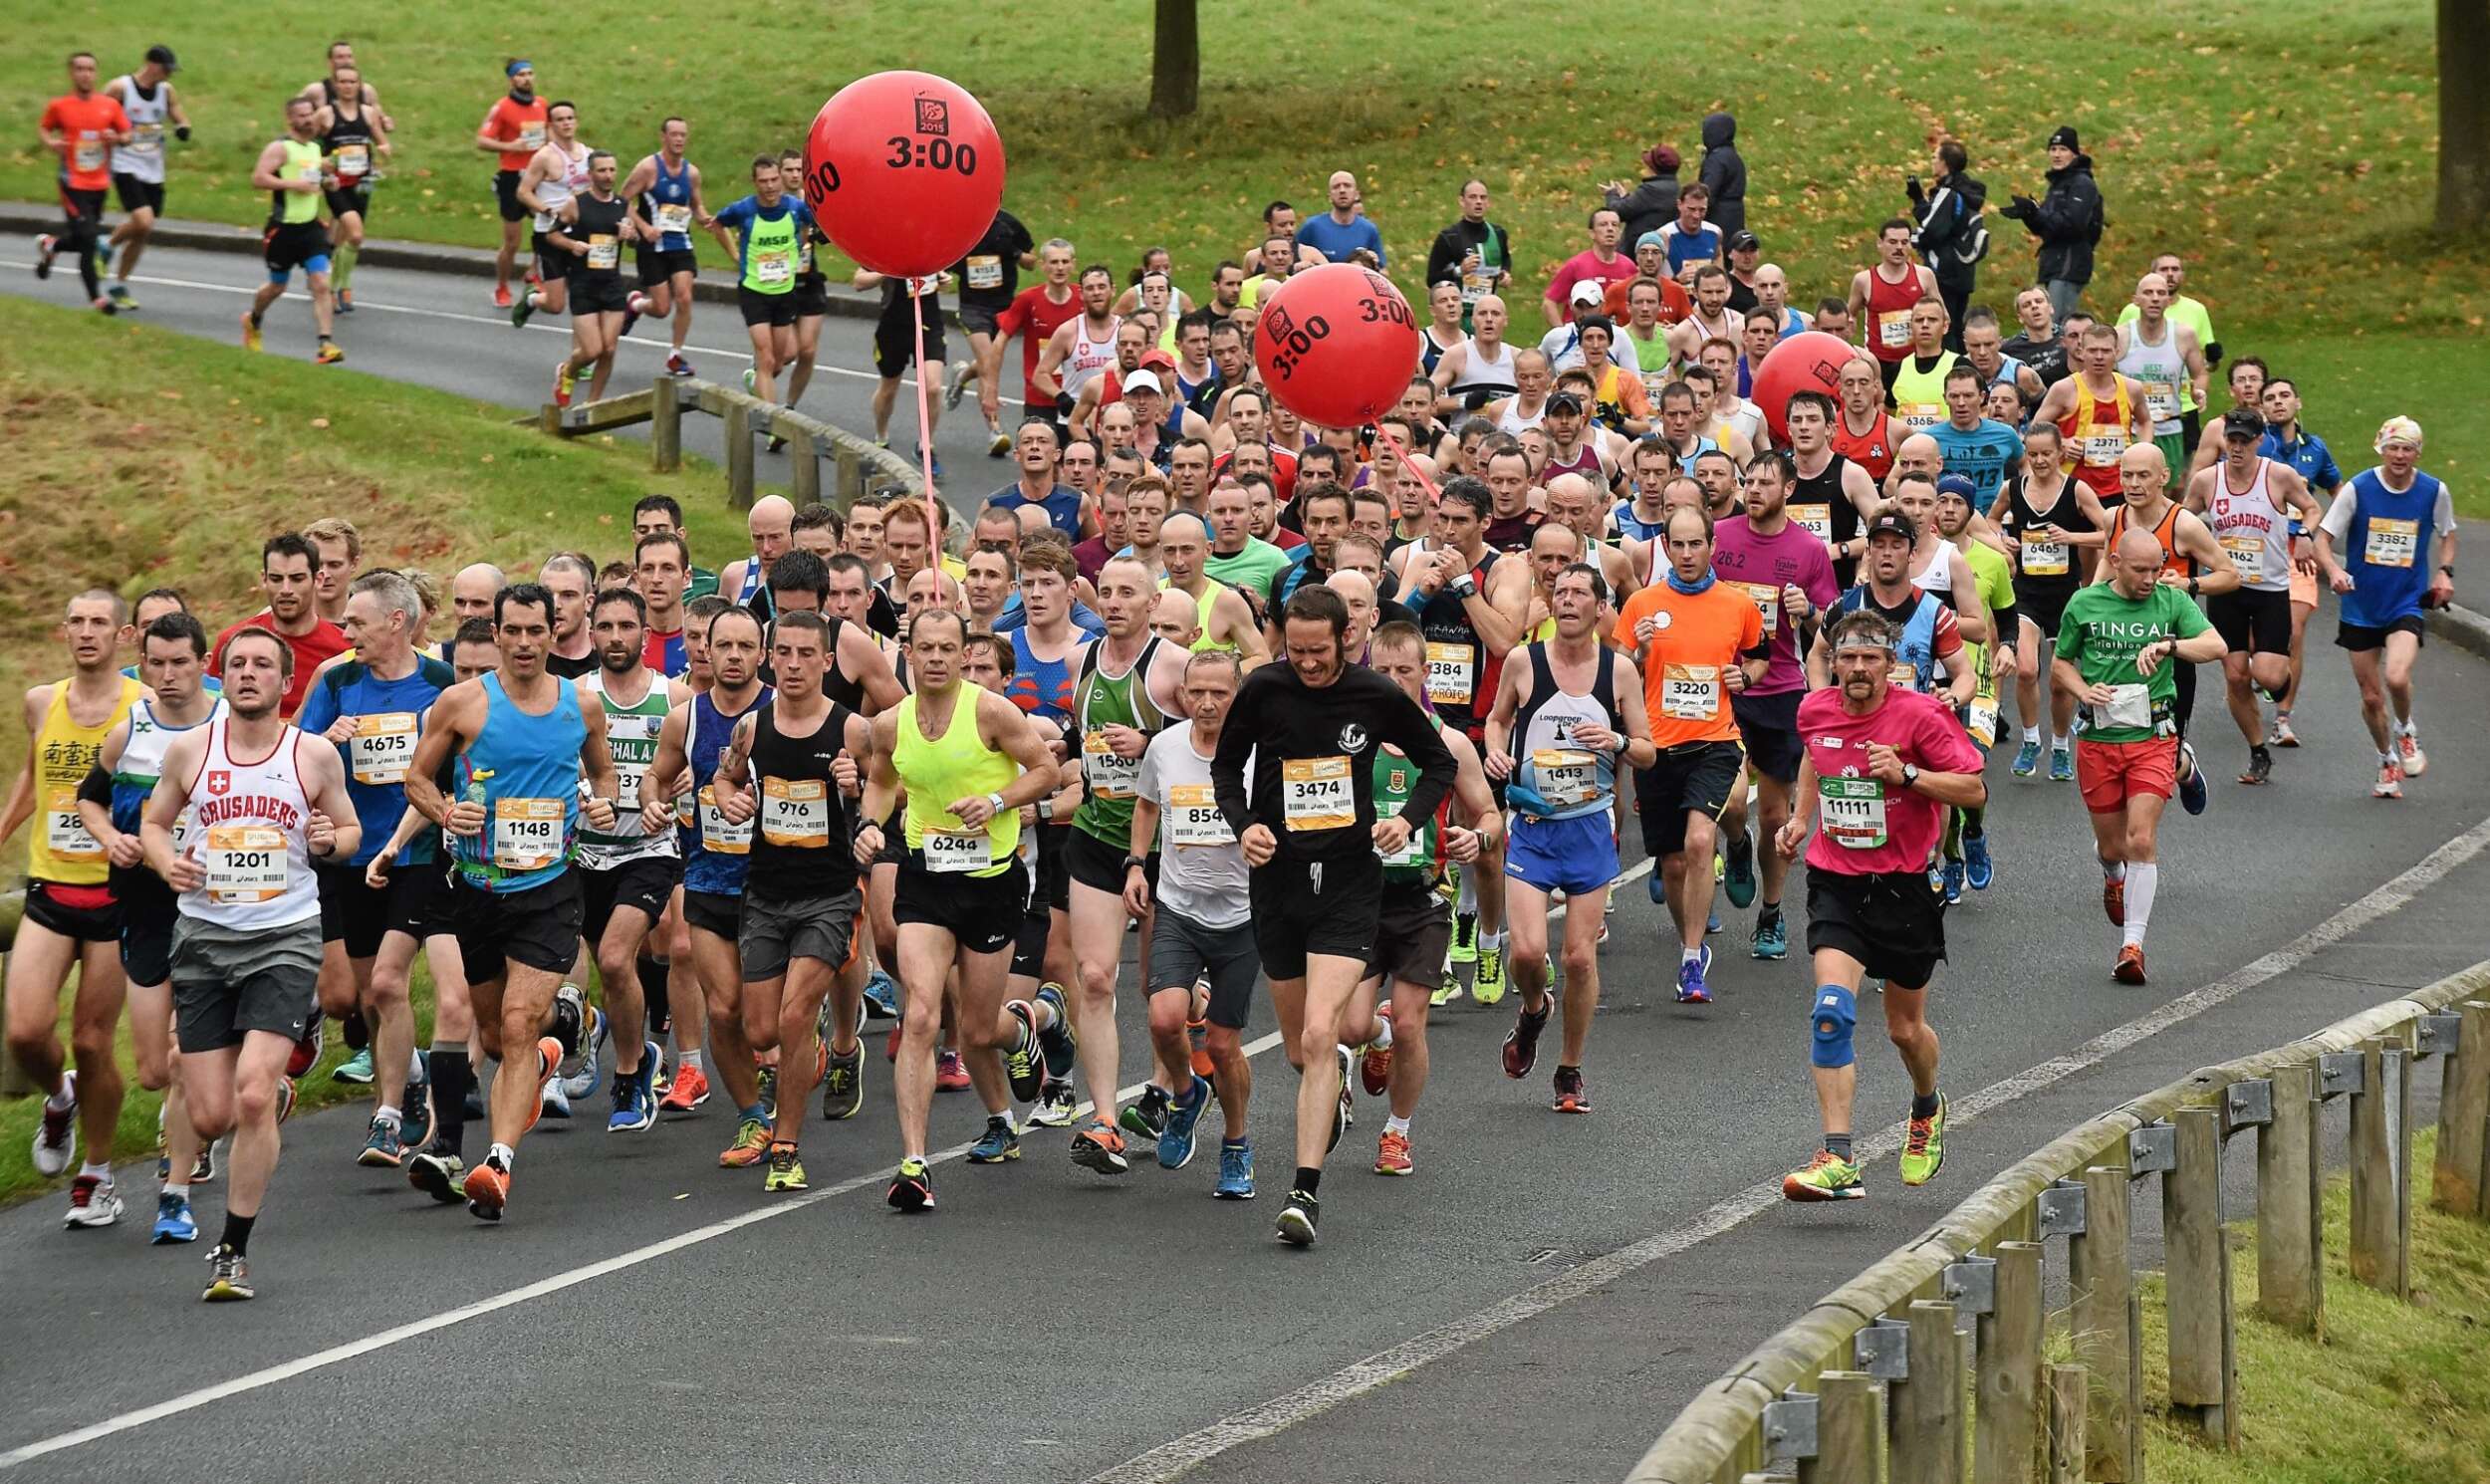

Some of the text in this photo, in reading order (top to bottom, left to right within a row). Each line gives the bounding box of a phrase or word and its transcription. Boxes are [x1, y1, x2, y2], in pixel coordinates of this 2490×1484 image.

[920, 122, 945, 133] 2015
[886, 135, 976, 176] 3:00
[757, 235, 789, 246] MSB
[1359, 299, 1415, 332] 3:00
[1272, 315, 1331, 381] 3:00
[2095, 437, 2119, 447] 2371
[2376, 533, 2407, 546] 3382
[2030, 543, 2060, 554] 6465
[1717, 551, 1746, 569] 26.2
[2090, 620, 2170, 637] FINGAL
[1428, 662, 1462, 676] 384
[1673, 682, 1710, 695] 3220
[1539, 714, 1583, 724] Loopgroep
[363, 735, 406, 752] 4675
[1547, 767, 1584, 782] 1413
[1295, 780, 1341, 798] 3474
[199, 795, 299, 831] CRUSADERS
[778, 801, 810, 817] 976
[1828, 799, 1870, 815] 11111
[60, 814, 84, 829] 28
[1188, 808, 1223, 824] 854
[508, 822, 551, 837] 1148
[932, 837, 978, 851] 6244
[224, 853, 271, 868] 1201
